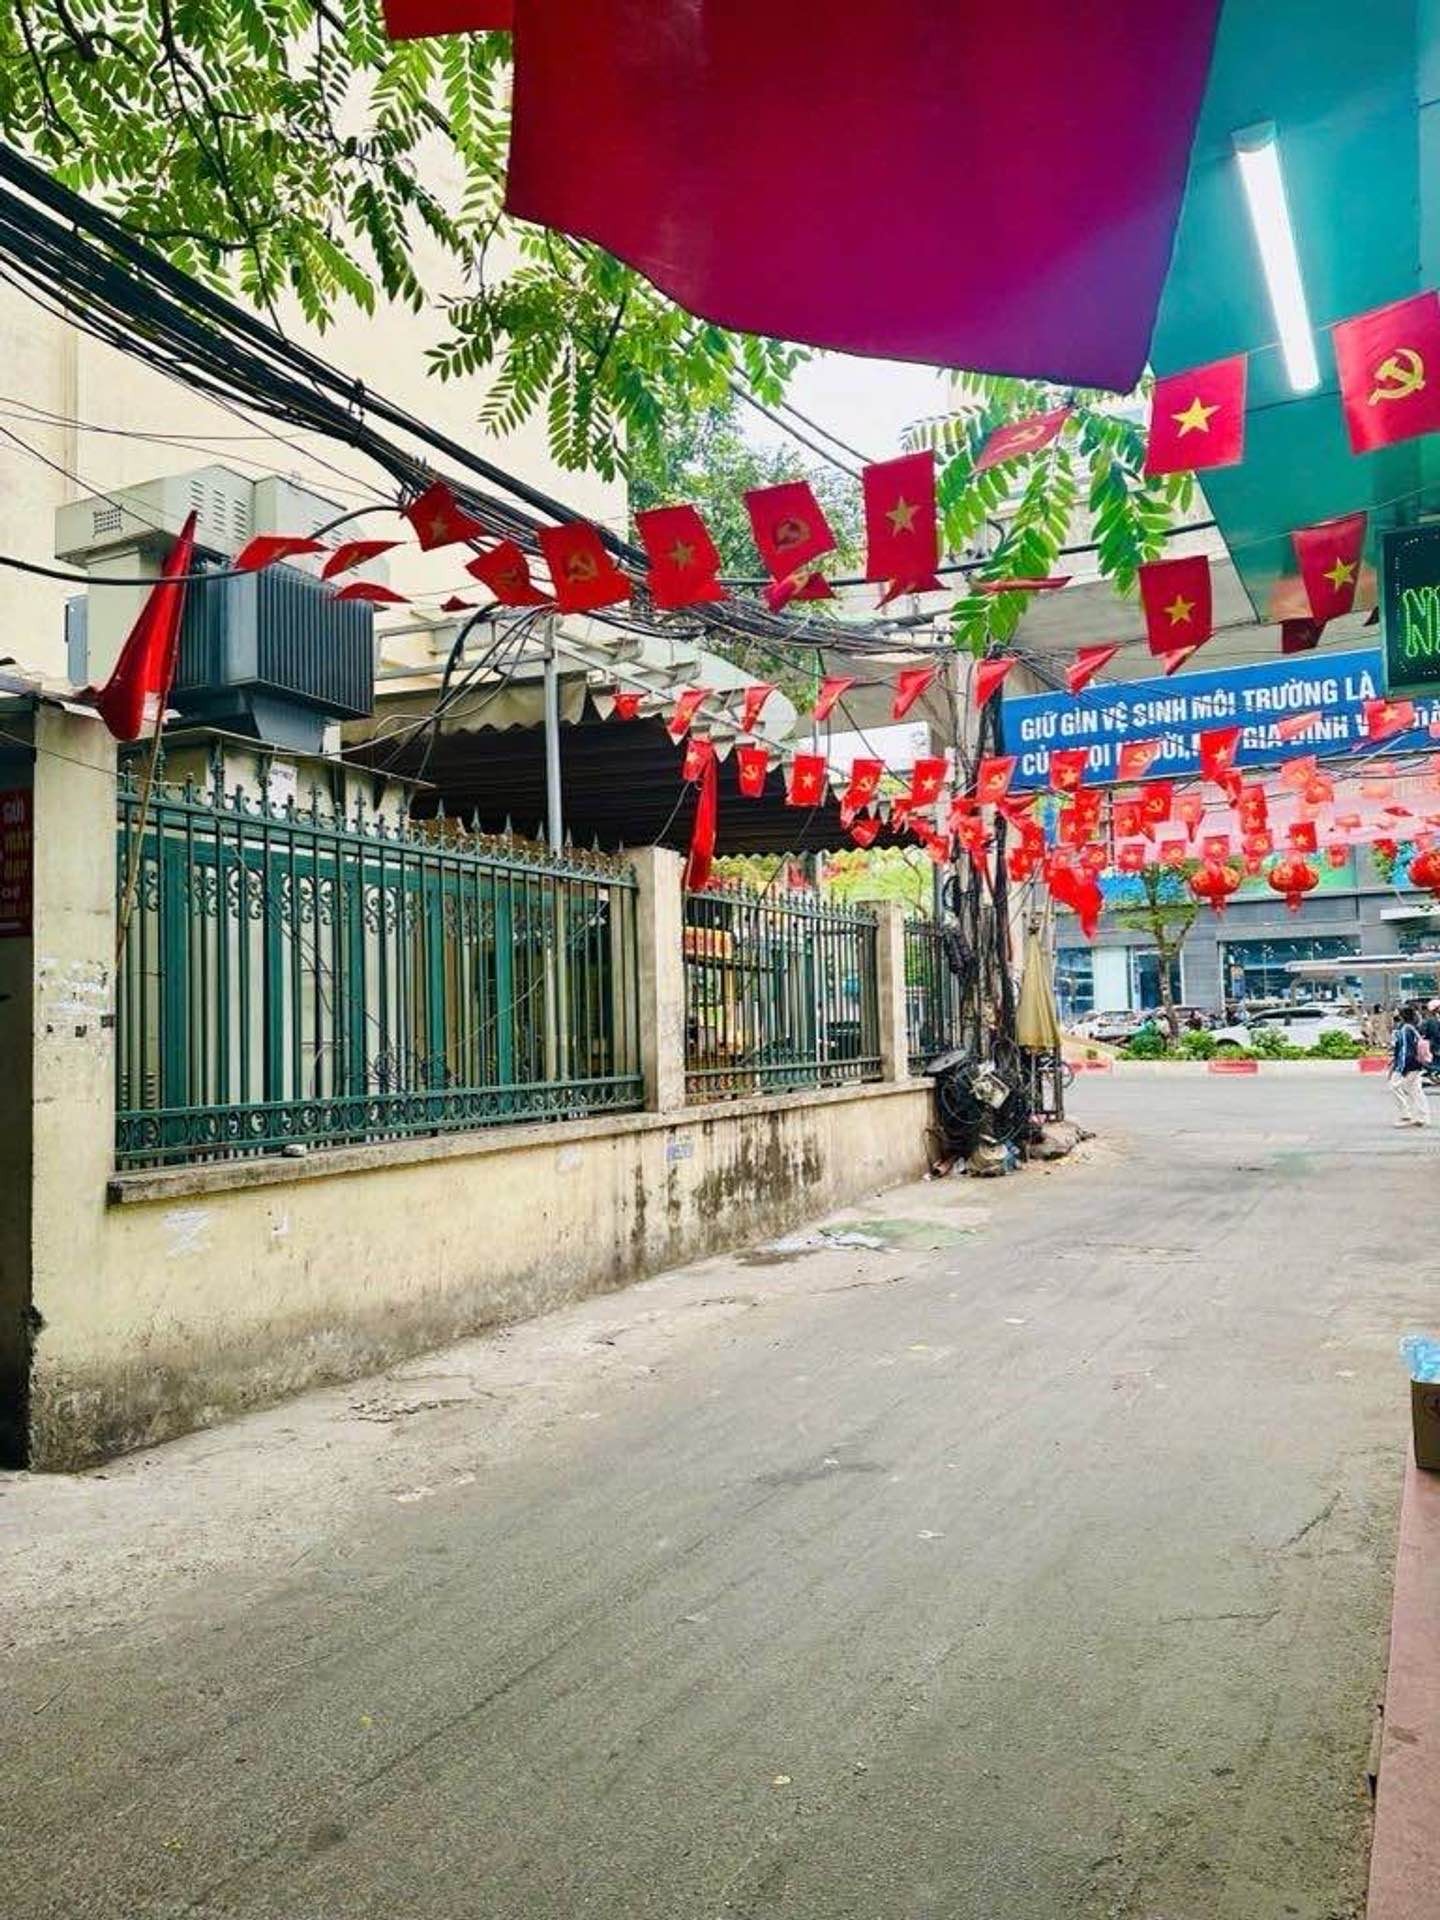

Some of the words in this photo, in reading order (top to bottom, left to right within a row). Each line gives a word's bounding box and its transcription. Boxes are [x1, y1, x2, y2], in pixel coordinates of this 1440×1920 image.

[1021, 711, 1057, 741] GIỮ
[1060, 706, 1098, 737] GÌN
[1101, 702, 1129, 733] VỆ
[1133, 698, 1187, 728] SINH
[1192, 688, 1236, 720] MÔI
[1242, 678, 1339, 712] TRƯỜNG
[1346, 669, 1377, 701] LÀ
[1021, 744, 1054, 776] CỦ
[1077, 743, 1110, 773] ỌI
